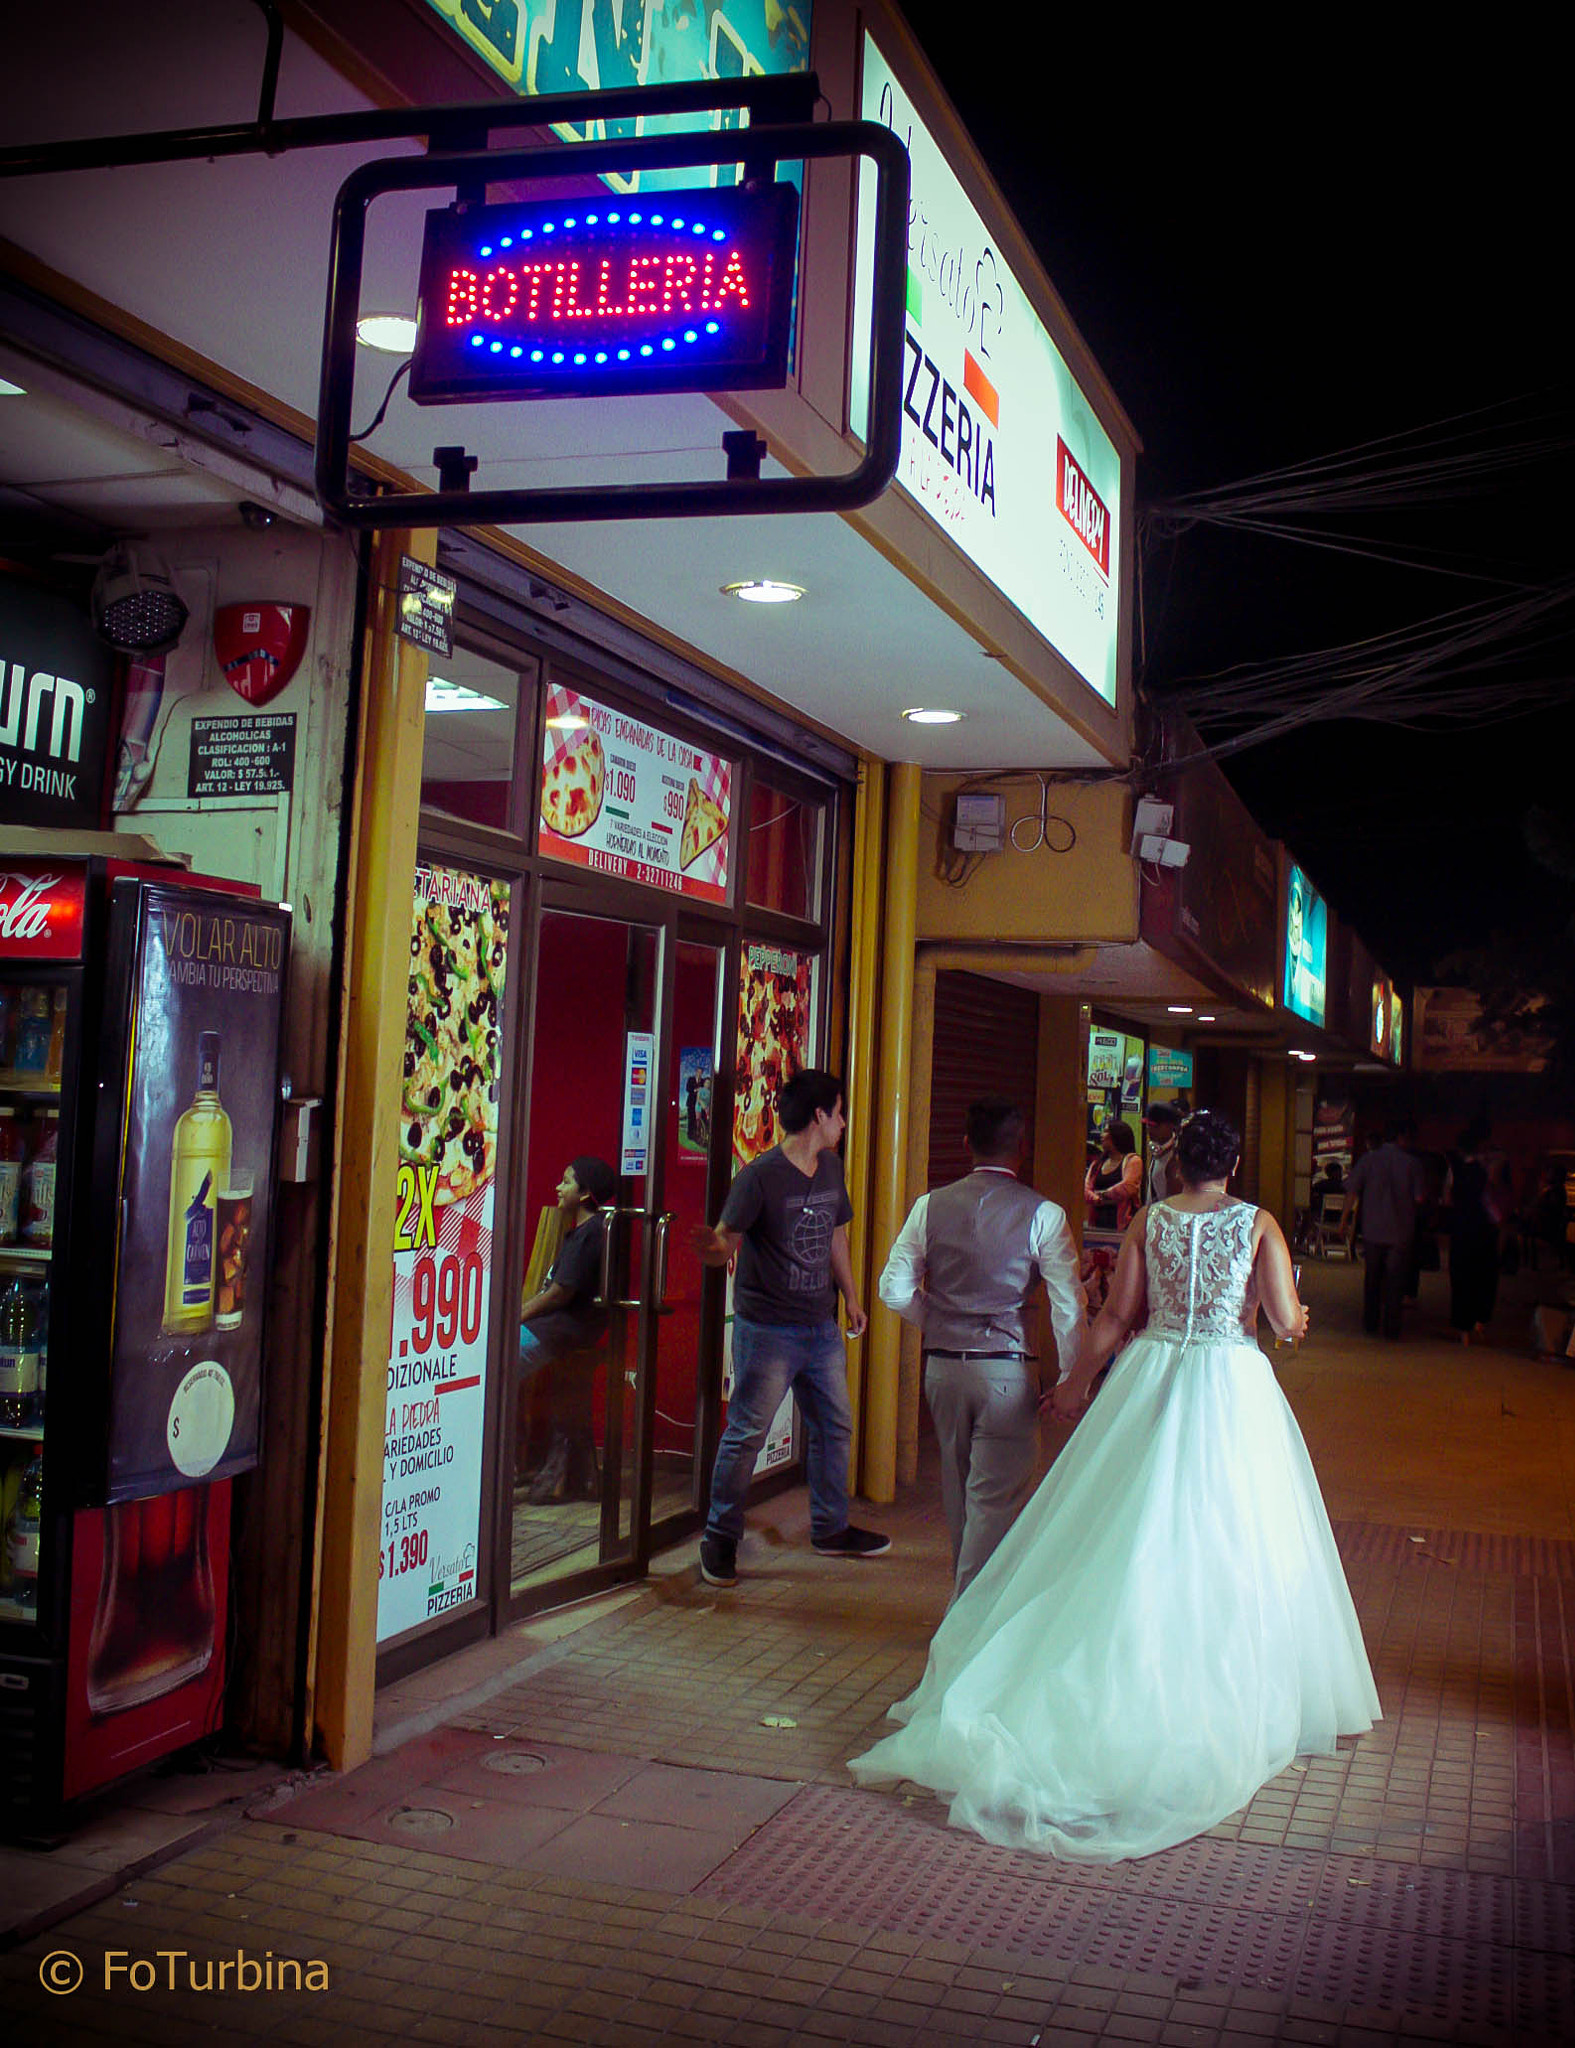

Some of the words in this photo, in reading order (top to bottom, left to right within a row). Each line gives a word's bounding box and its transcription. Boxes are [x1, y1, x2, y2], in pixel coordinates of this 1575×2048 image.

[446, 252, 749, 326] BOTILLERIA
[904, 330, 996, 518] ZZERIA
[1064, 454, 1105, 564] DELIVERY
[195, 719, 239, 730] EXPENDIO
[241, 718, 253, 729] DE
[255, 716, 294, 728] BEBIDAS
[209, 730, 271, 742] ALCOHOLICAS
[198, 743, 265, 755] CLASIFICACION
[272, 742, 286, 752] A-1
[212, 757, 233, 768] ROL:
[657, 736, 665, 757] DE
[667, 741, 676, 763] LA
[21, 763, 77, 800] DRINK
[195, 782, 214, 793] ART.
[217, 782, 227, 792] 12
[234, 781, 252, 791] LEY
[204, 770, 236, 780] VALOR:
[588, 849, 628, 875] DELIVERY
[638, 842, 645, 859] AL
[413, 867, 492, 915] TARIANA
[163, 910, 235, 963] VOLAR
[239, 922, 282, 970] ALTO
[169, 960, 206, 986] AMBIA
[208, 964, 221, 988] TU
[222, 967, 279, 994] PERSPECTIVA
[394, 1163, 440, 1252] 2X
[173, 1416, 180, 1439] $
[402, 1397, 440, 1435] PIEDRA
[390, 1461, 397, 1480] Y
[401, 1445, 453, 1477] DOMICILIO
[385, 1498, 406, 1518] C/LA
[409, 1486, 440, 1510] PROMO
[402, 1511, 417, 1531] LTS
[427, 1582, 473, 1616] PIZZERIA
